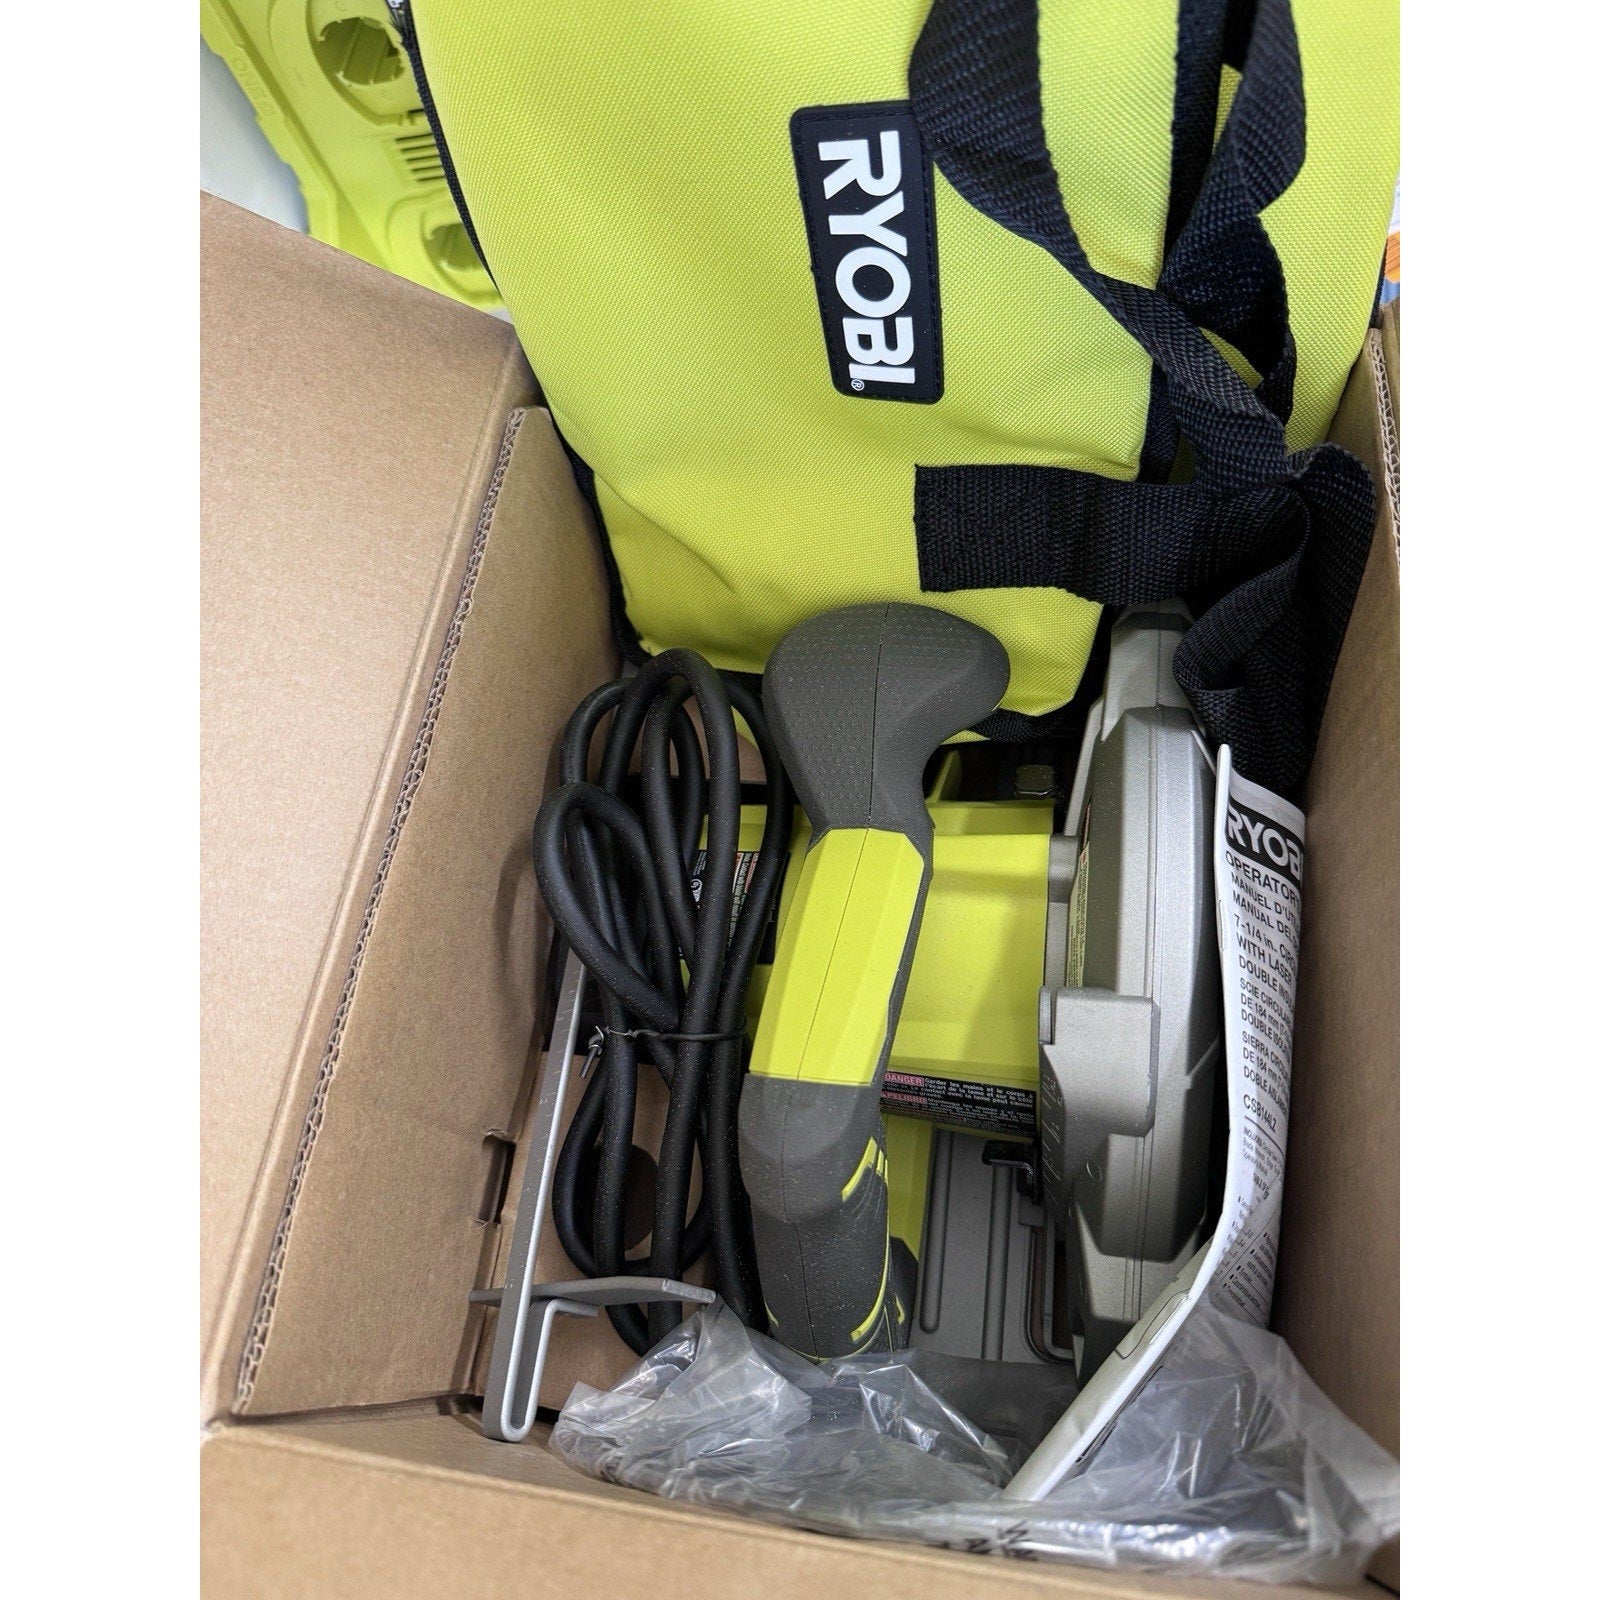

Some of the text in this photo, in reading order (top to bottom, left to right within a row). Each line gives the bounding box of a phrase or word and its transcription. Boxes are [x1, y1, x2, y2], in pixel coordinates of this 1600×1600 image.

[817, 129, 916, 384] RYOBI
[1231, 871, 1272, 911] MANUEL
[1233, 889, 1275, 929] MANUAL
[1234, 913, 1263, 943] 7-1/4
[1236, 932, 1266, 964] WITH
[1239, 954, 1278, 992] DOUBLE
[1240, 977, 1259, 999] SCIE
[1240, 992, 1253, 1010] DE
[1241, 1008, 1273, 1040] DOUBLE
[1242, 1030, 1270, 1060] SIERRA
[1243, 1046, 1255, 1064] DE
[1244, 1065, 1268, 1093] DOBLE
